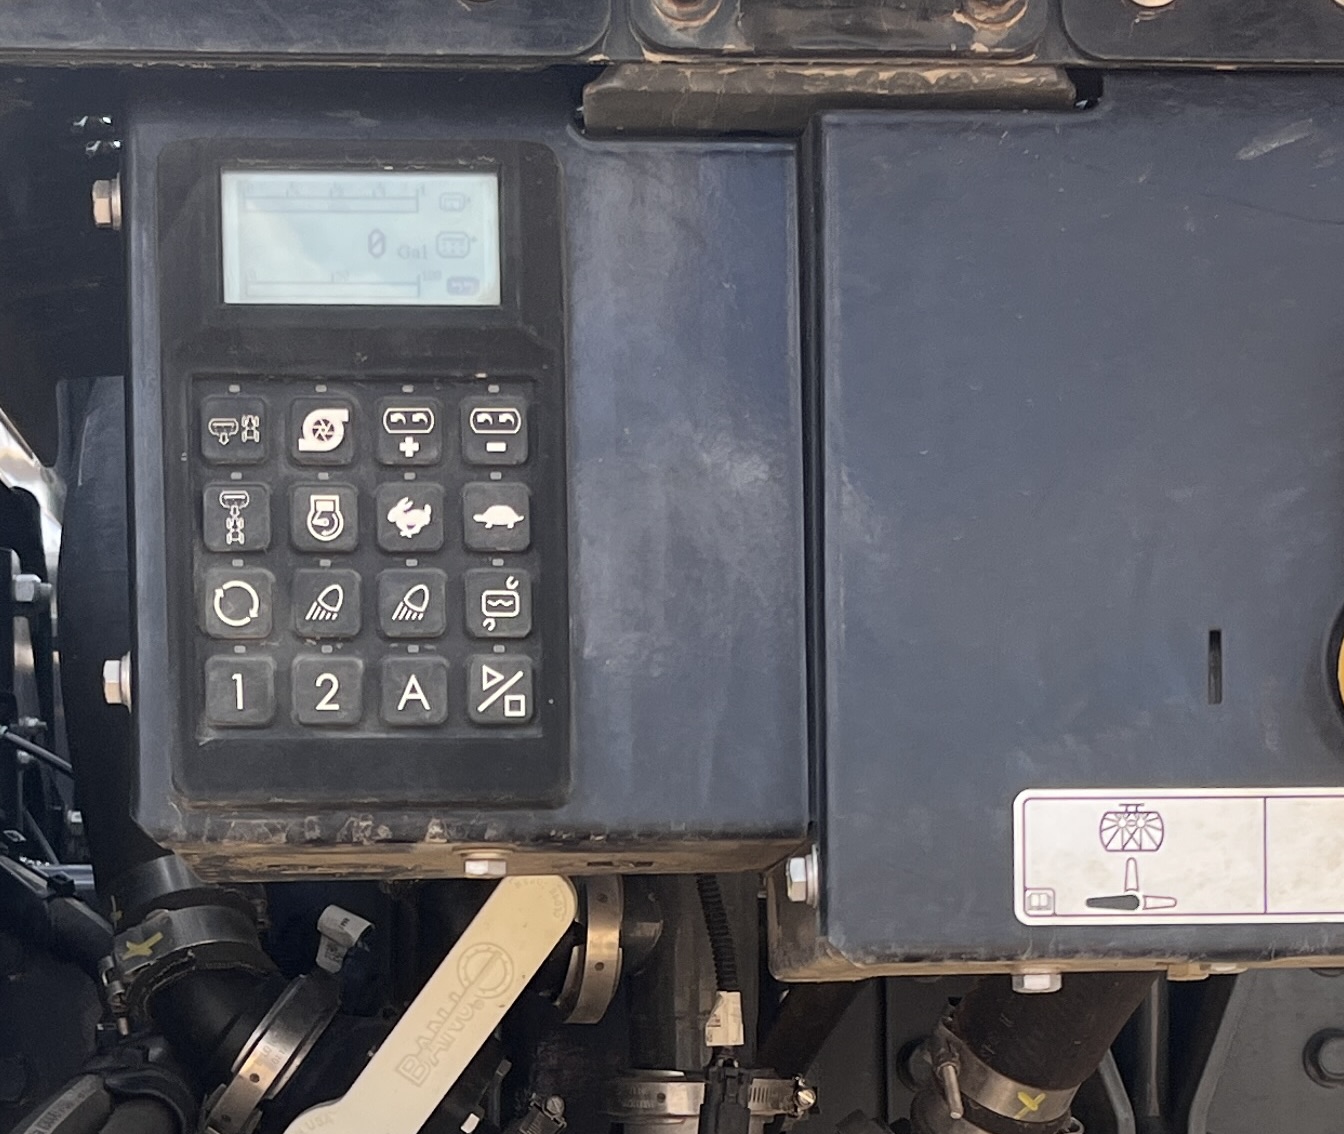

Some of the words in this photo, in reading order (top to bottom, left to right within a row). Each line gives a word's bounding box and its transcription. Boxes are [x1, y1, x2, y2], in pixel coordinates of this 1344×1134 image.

[367, 228, 386, 258] 0
[397, 245, 429, 260] Gal
[232, 672, 244, 710] 1
[315, 672, 340, 710] 2
[397, 674, 430, 710] A
